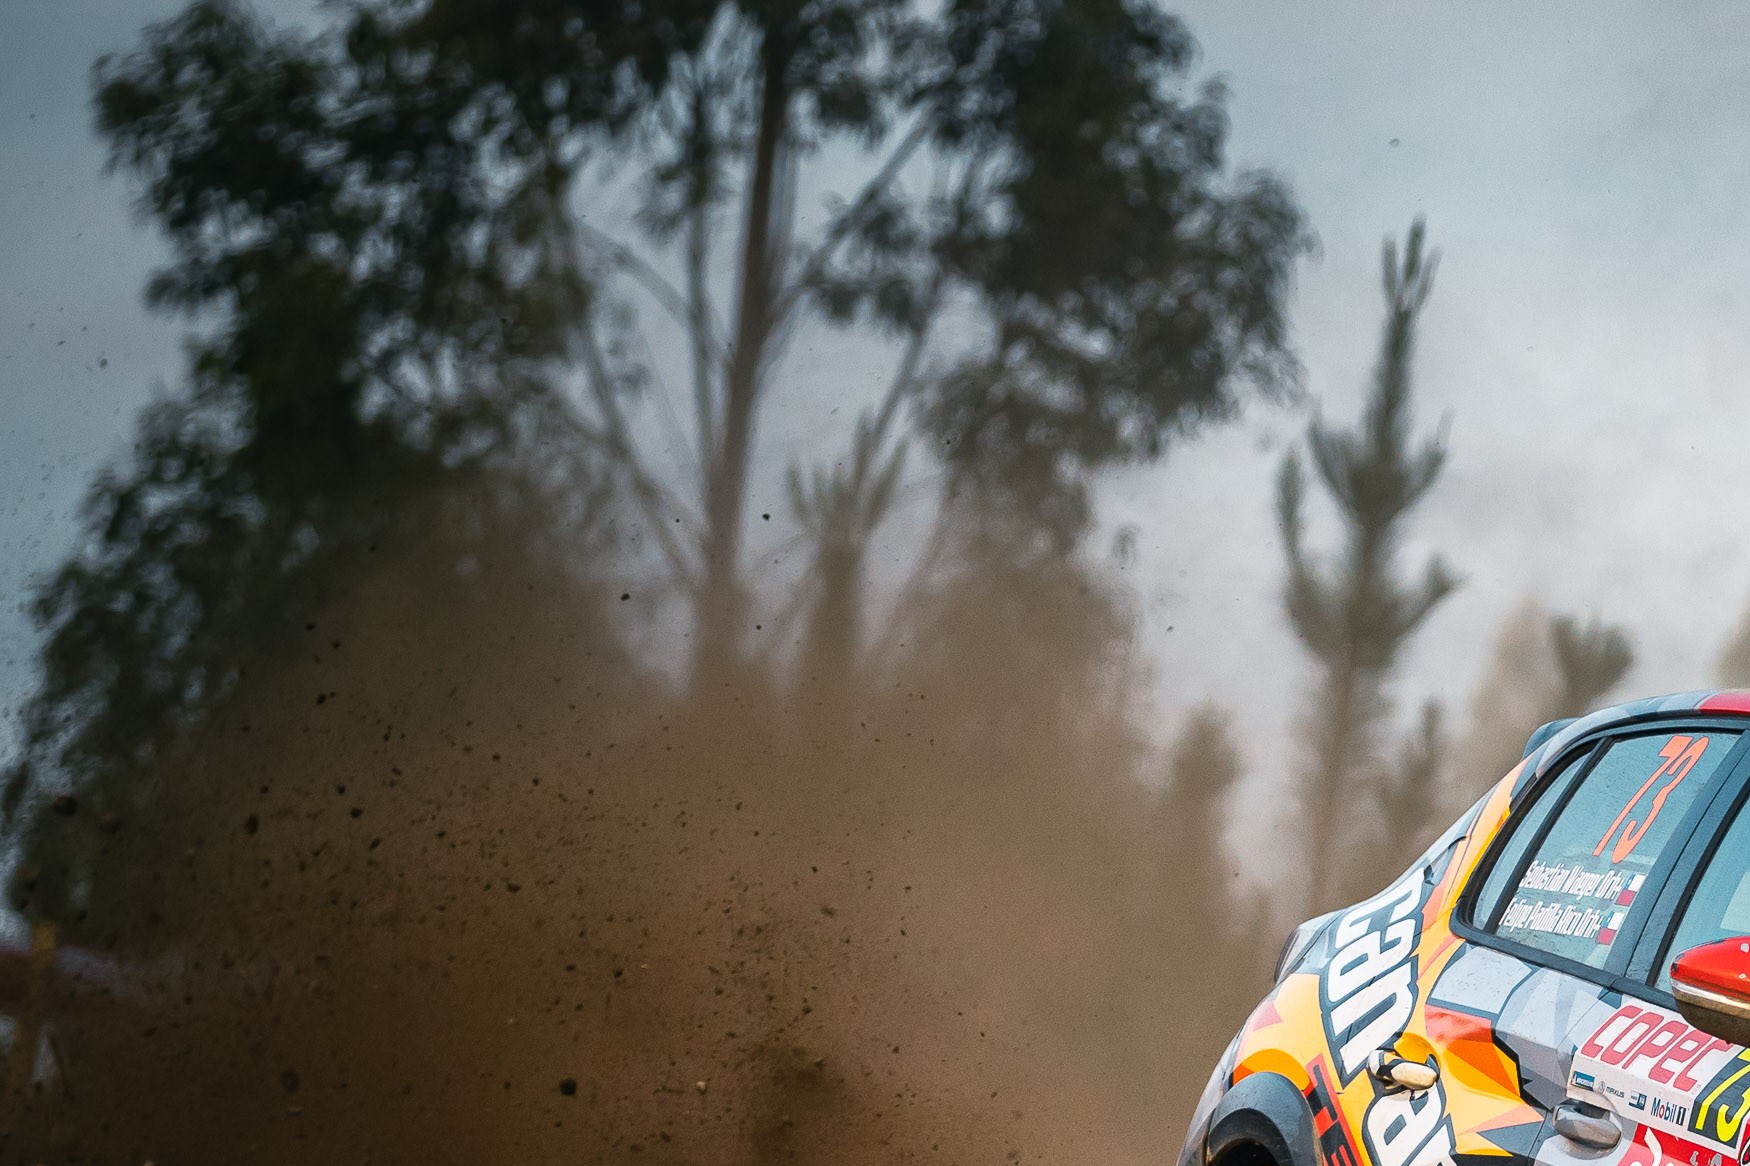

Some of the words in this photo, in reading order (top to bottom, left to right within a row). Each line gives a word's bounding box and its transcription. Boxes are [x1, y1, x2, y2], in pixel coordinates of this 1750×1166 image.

[1592, 735, 1710, 864] 73
[1519, 860, 1570, 892] Sebastian
[1651, 1097, 1677, 1123] Mobil
